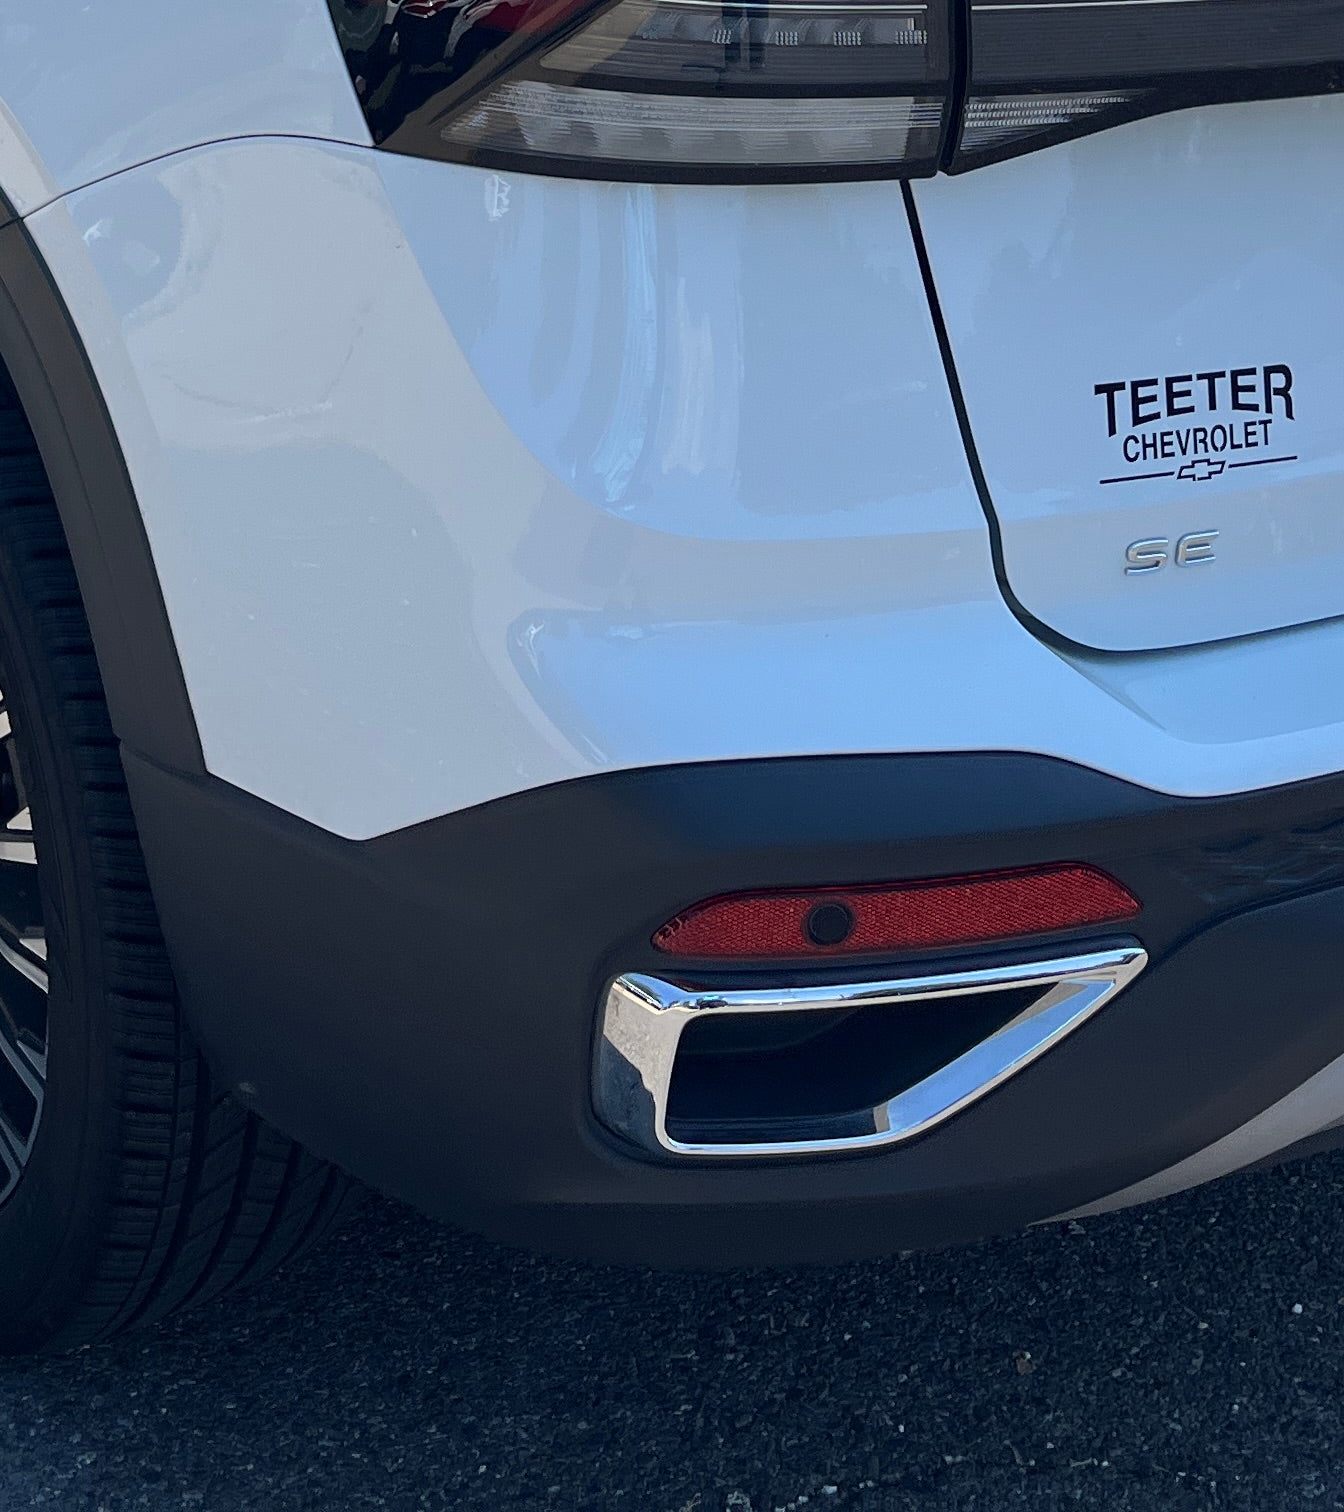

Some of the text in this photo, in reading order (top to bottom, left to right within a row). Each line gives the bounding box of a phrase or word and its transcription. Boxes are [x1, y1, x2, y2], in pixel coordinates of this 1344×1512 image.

[1094, 364, 1295, 437] TEETER
[1123, 419, 1272, 463] CHEVROLET
[1124, 529, 1219, 576] SE
